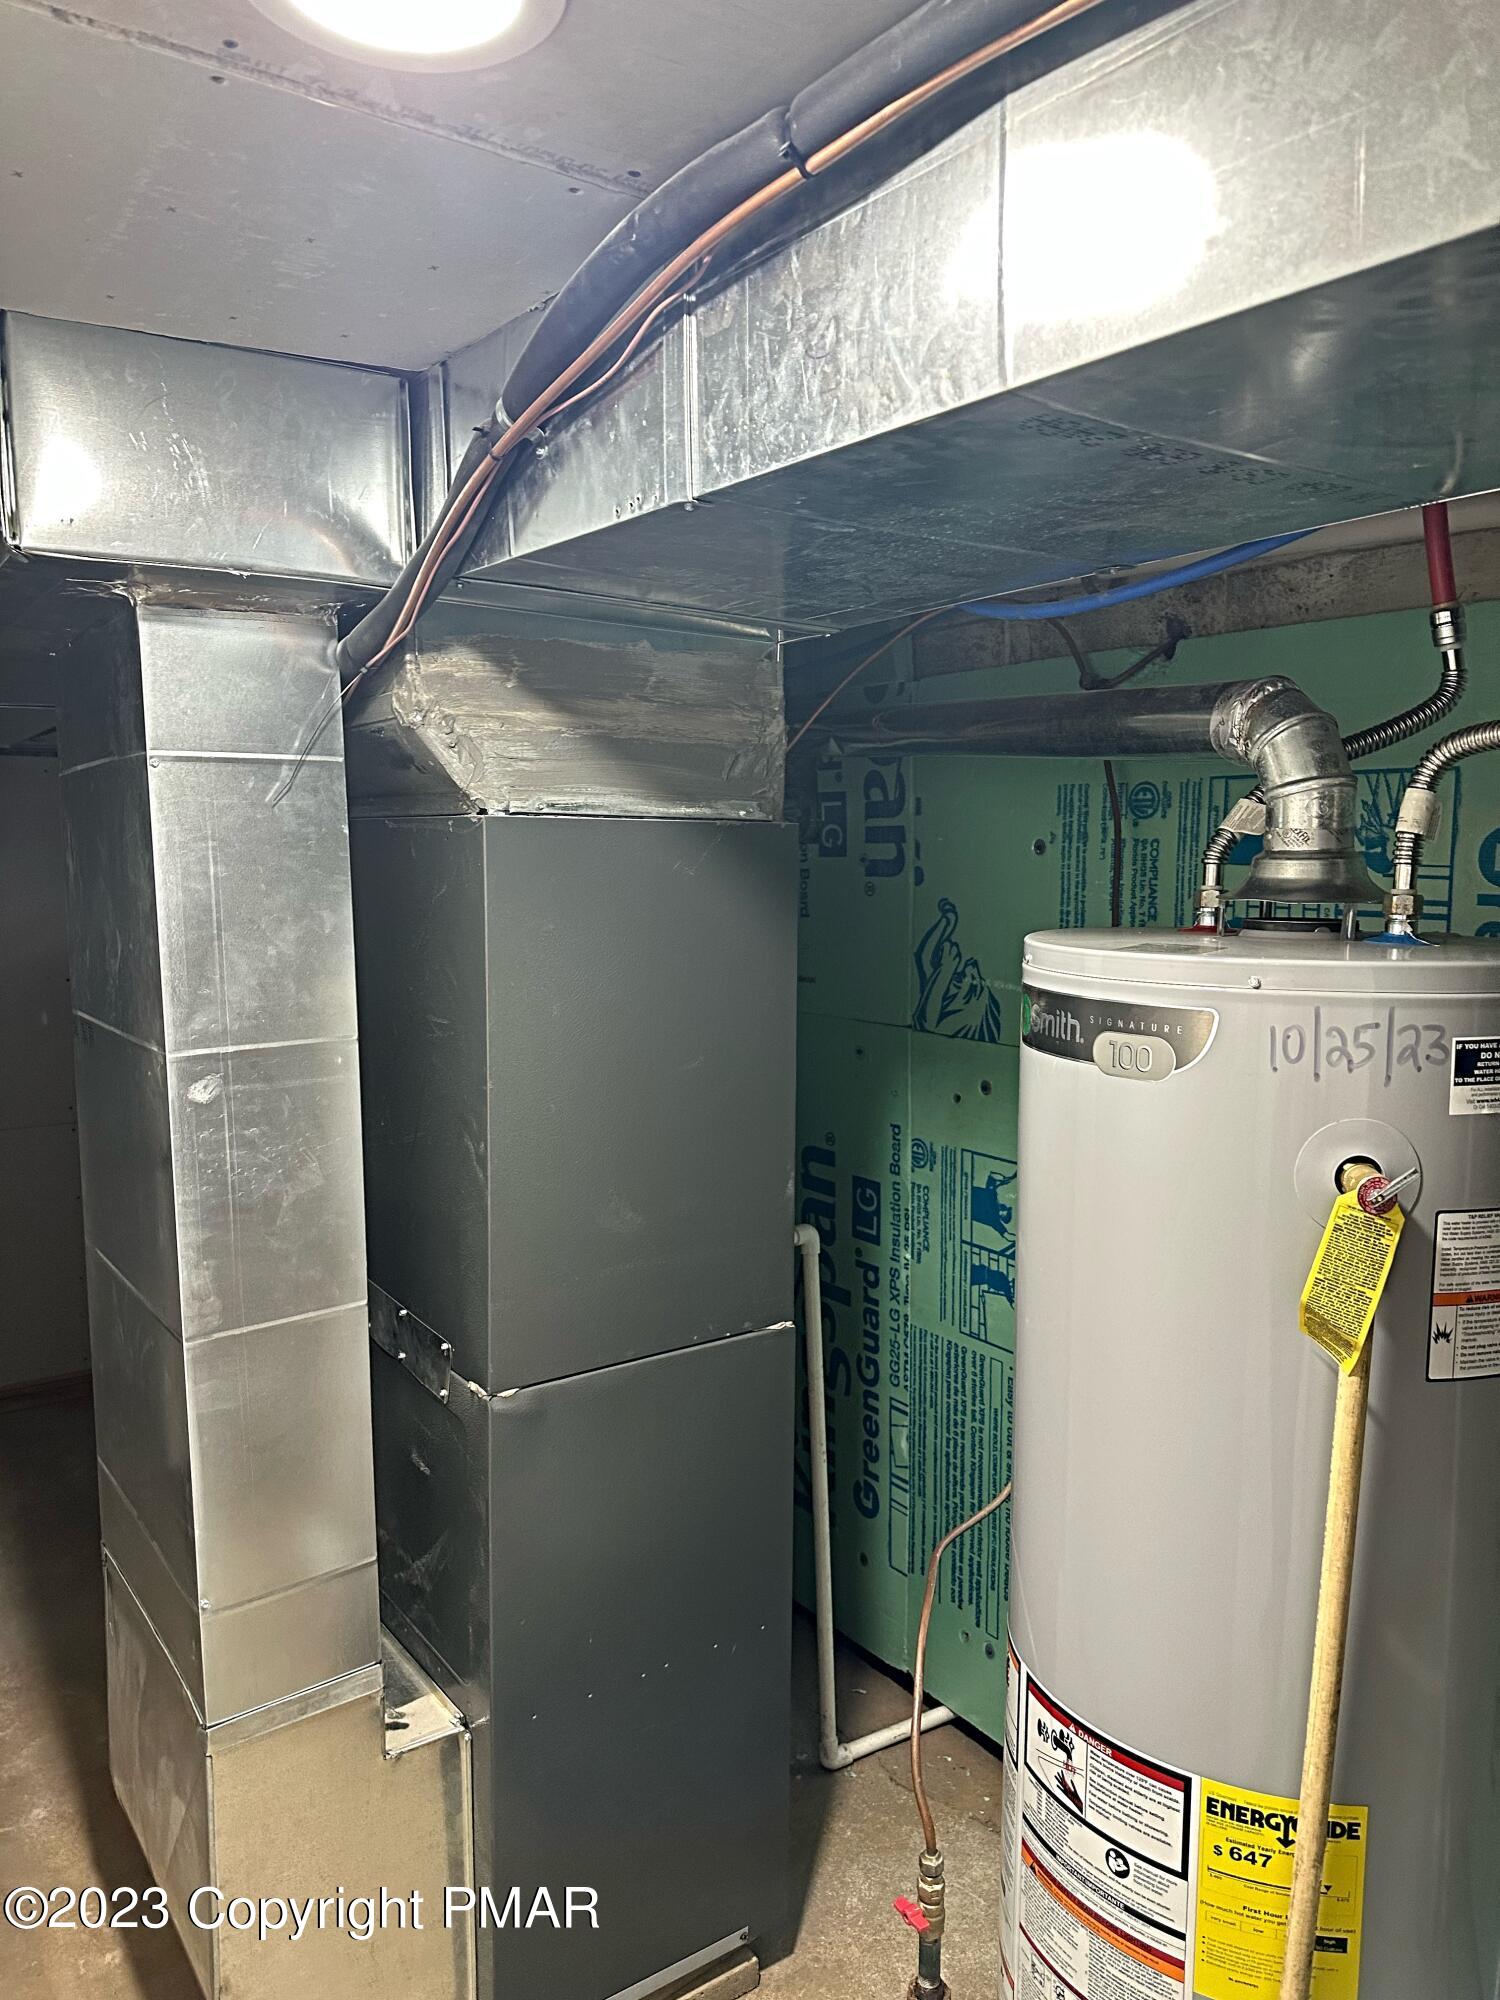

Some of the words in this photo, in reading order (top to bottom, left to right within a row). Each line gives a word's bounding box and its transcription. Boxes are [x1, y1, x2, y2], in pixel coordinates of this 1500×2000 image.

[821, 801, 843, 848] LG
[799, 869, 810, 918] Board
[1148, 838, 1160, 921] COMPLIANCE
[1090, 1015, 1185, 1035] SIGNATURE
[1108, 1039, 1153, 1073] 100
[888, 1122, 900, 1176] Board
[855, 1187, 878, 1236] LG
[888, 1181, 900, 1263] Insulation
[922, 1185, 930, 1253] COMPLIANCE
[889, 1267, 900, 1305] XPS
[888, 1308, 901, 1388] GG25-LG
[960, 1346, 968, 1398] GreenGuard
[970, 1426, 978, 1459] Contact
[1078, 1729, 1113, 1757] DANGER
[1213, 1844, 1223, 1857] $
[1229, 1846, 1272, 1868] 647
[1226, 1836, 1255, 1849] Estimated
[1257, 1844, 1276, 1855] Yearly
[1242, 1905, 1261, 1914] First
[1264, 1910, 1282, 1919] Hour
